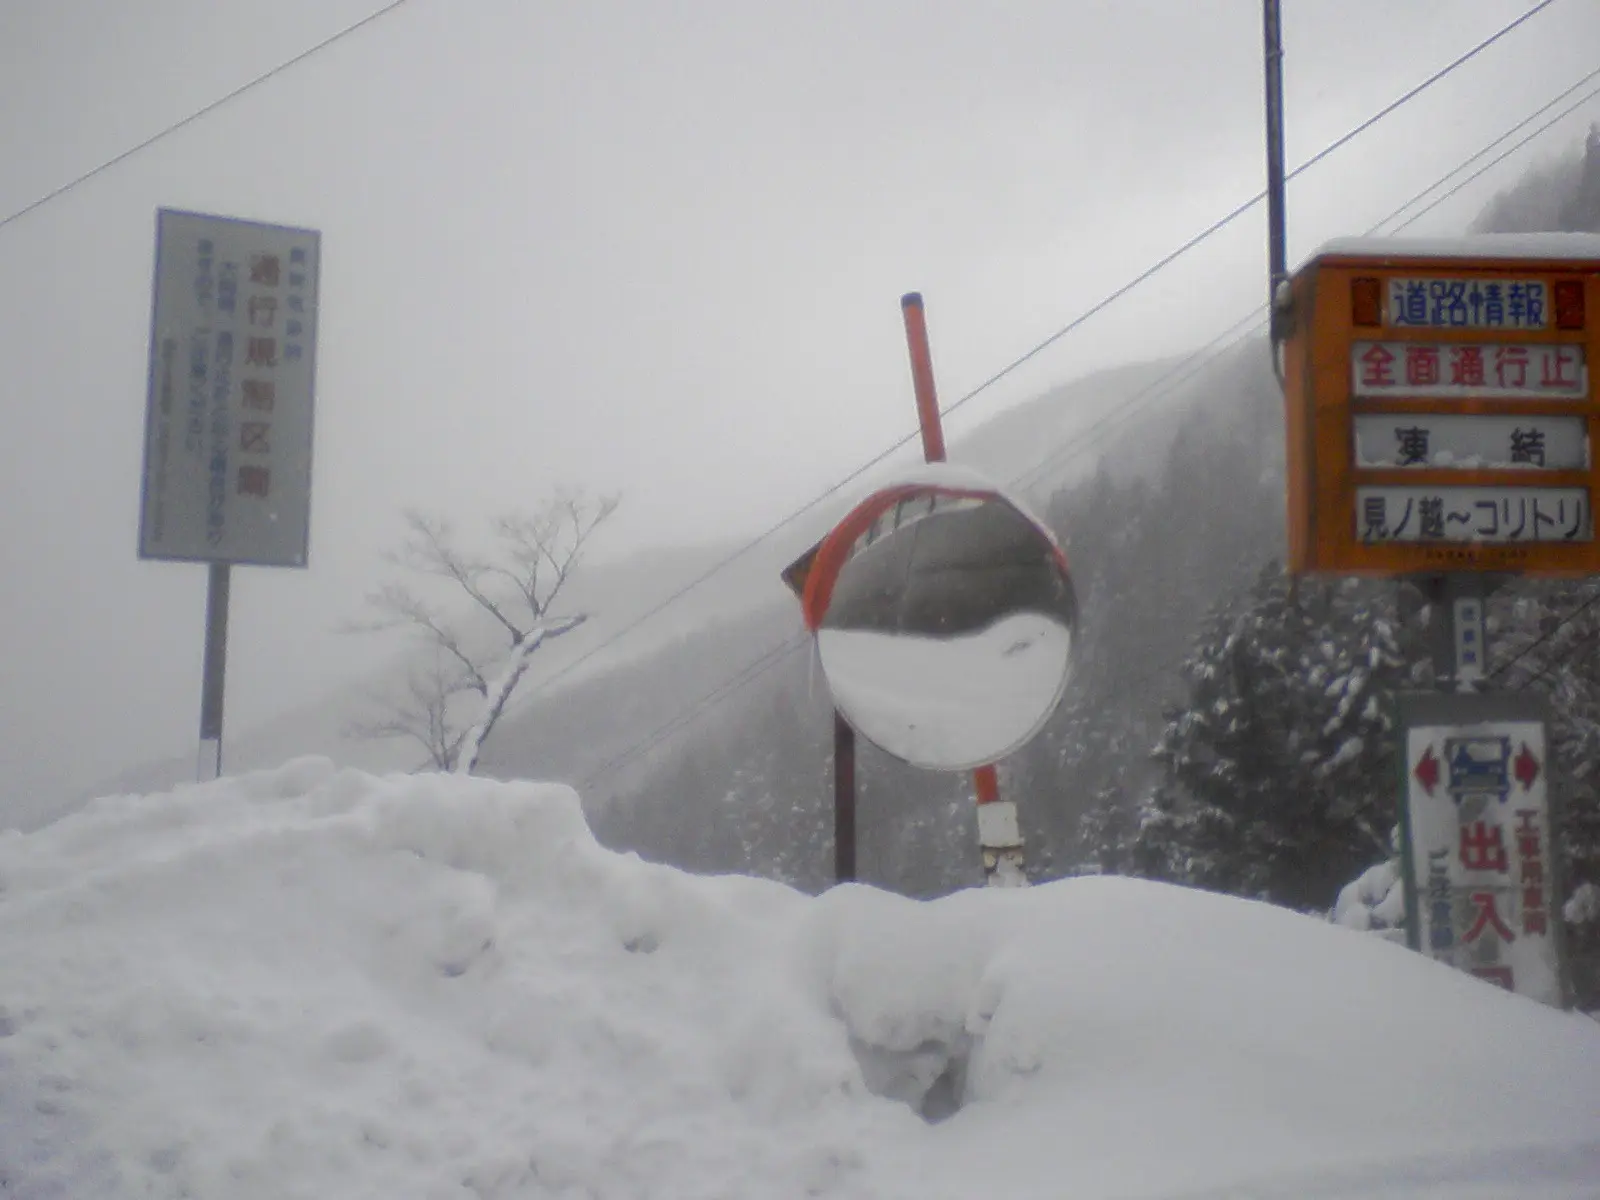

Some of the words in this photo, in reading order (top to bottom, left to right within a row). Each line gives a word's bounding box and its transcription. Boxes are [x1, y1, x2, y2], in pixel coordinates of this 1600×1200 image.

[1394, 279, 1544, 327] 道路情報
[1361, 344, 1578, 388] 全面通行止
